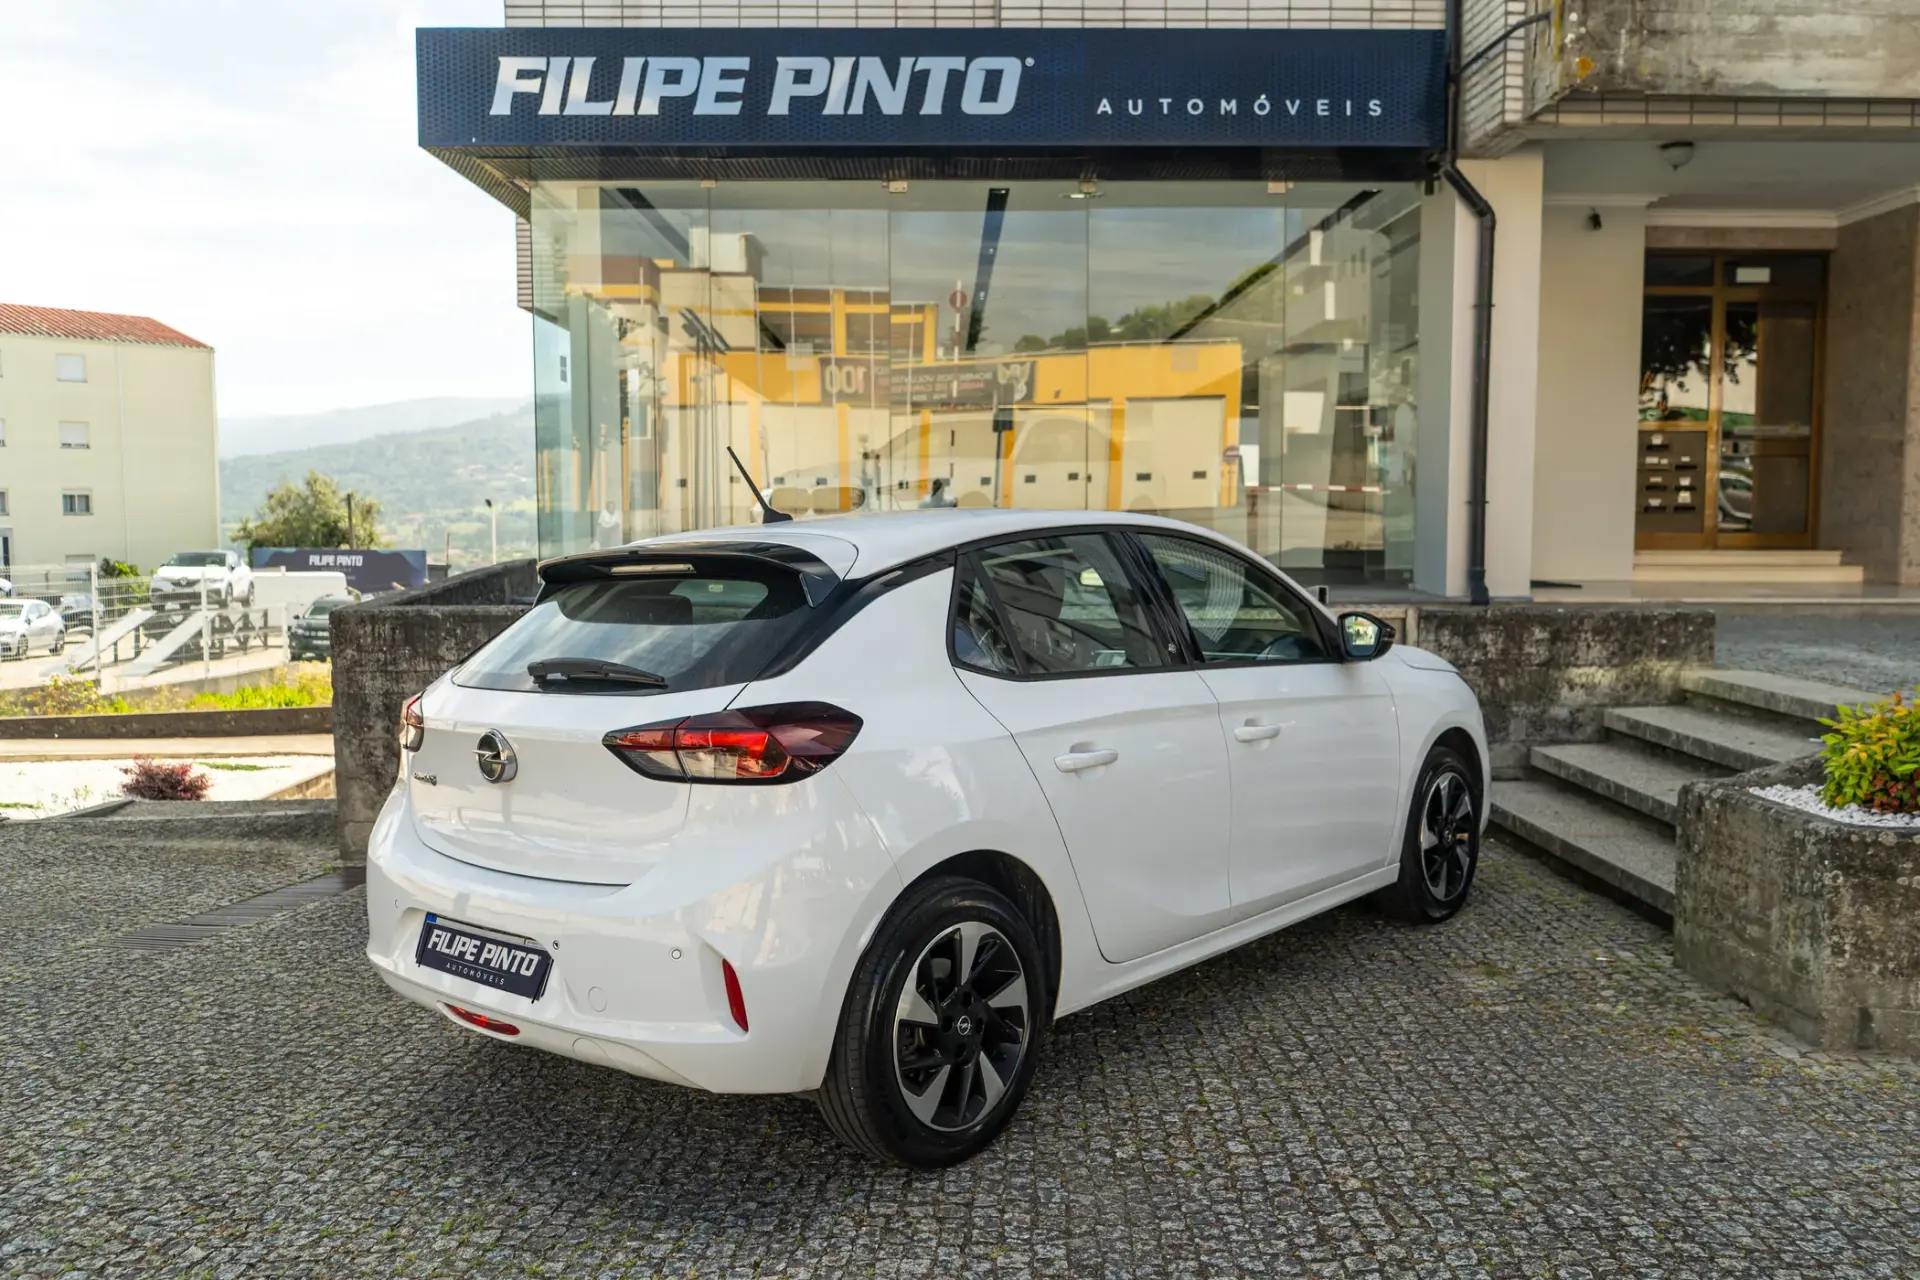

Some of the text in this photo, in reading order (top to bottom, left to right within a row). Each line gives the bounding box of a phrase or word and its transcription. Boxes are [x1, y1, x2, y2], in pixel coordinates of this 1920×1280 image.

[489, 56, 750, 116] FILIPE
[1097, 94, 1383, 116] AUTOMÓVEIS
[427, 928, 540, 977] FILIPE PINTO
[446, 963, 505, 985] AUTOMÓVEIS
